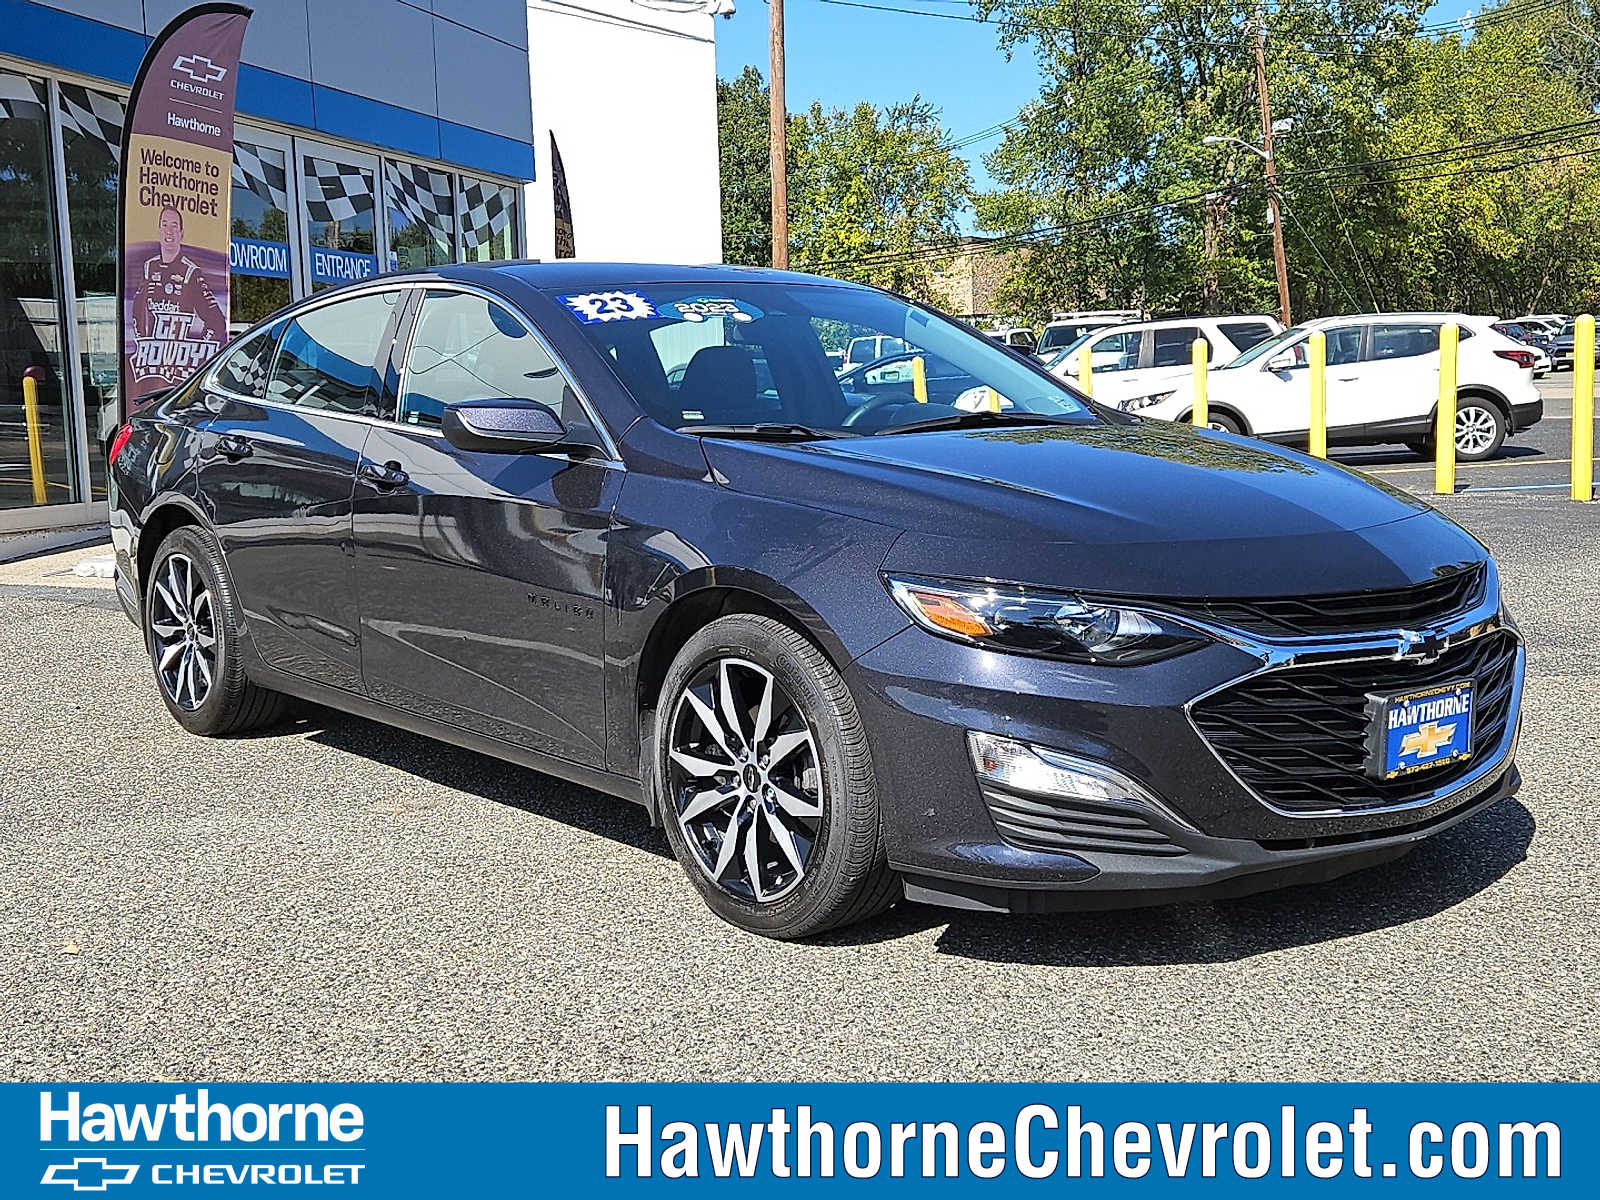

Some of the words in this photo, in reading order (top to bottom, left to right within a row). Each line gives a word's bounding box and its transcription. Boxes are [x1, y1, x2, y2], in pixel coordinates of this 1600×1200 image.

[170, 80, 224, 100] CHEVROLET
[167, 112, 221, 136] Hawthorne
[140, 147, 202, 174] Welcome
[205, 161, 220, 178] to
[139, 166, 219, 196] Hawthorne
[139, 185, 218, 217] Chevrolet
[315, 252, 372, 279] ENTRANCE
[588, 297, 635, 314] 23
[673, 302, 740, 313] 2023
[155, 313, 193, 341] GET
[527, 592, 594, 619] MALIBU
[1388, 694, 1470, 729] HAWTHORNE
